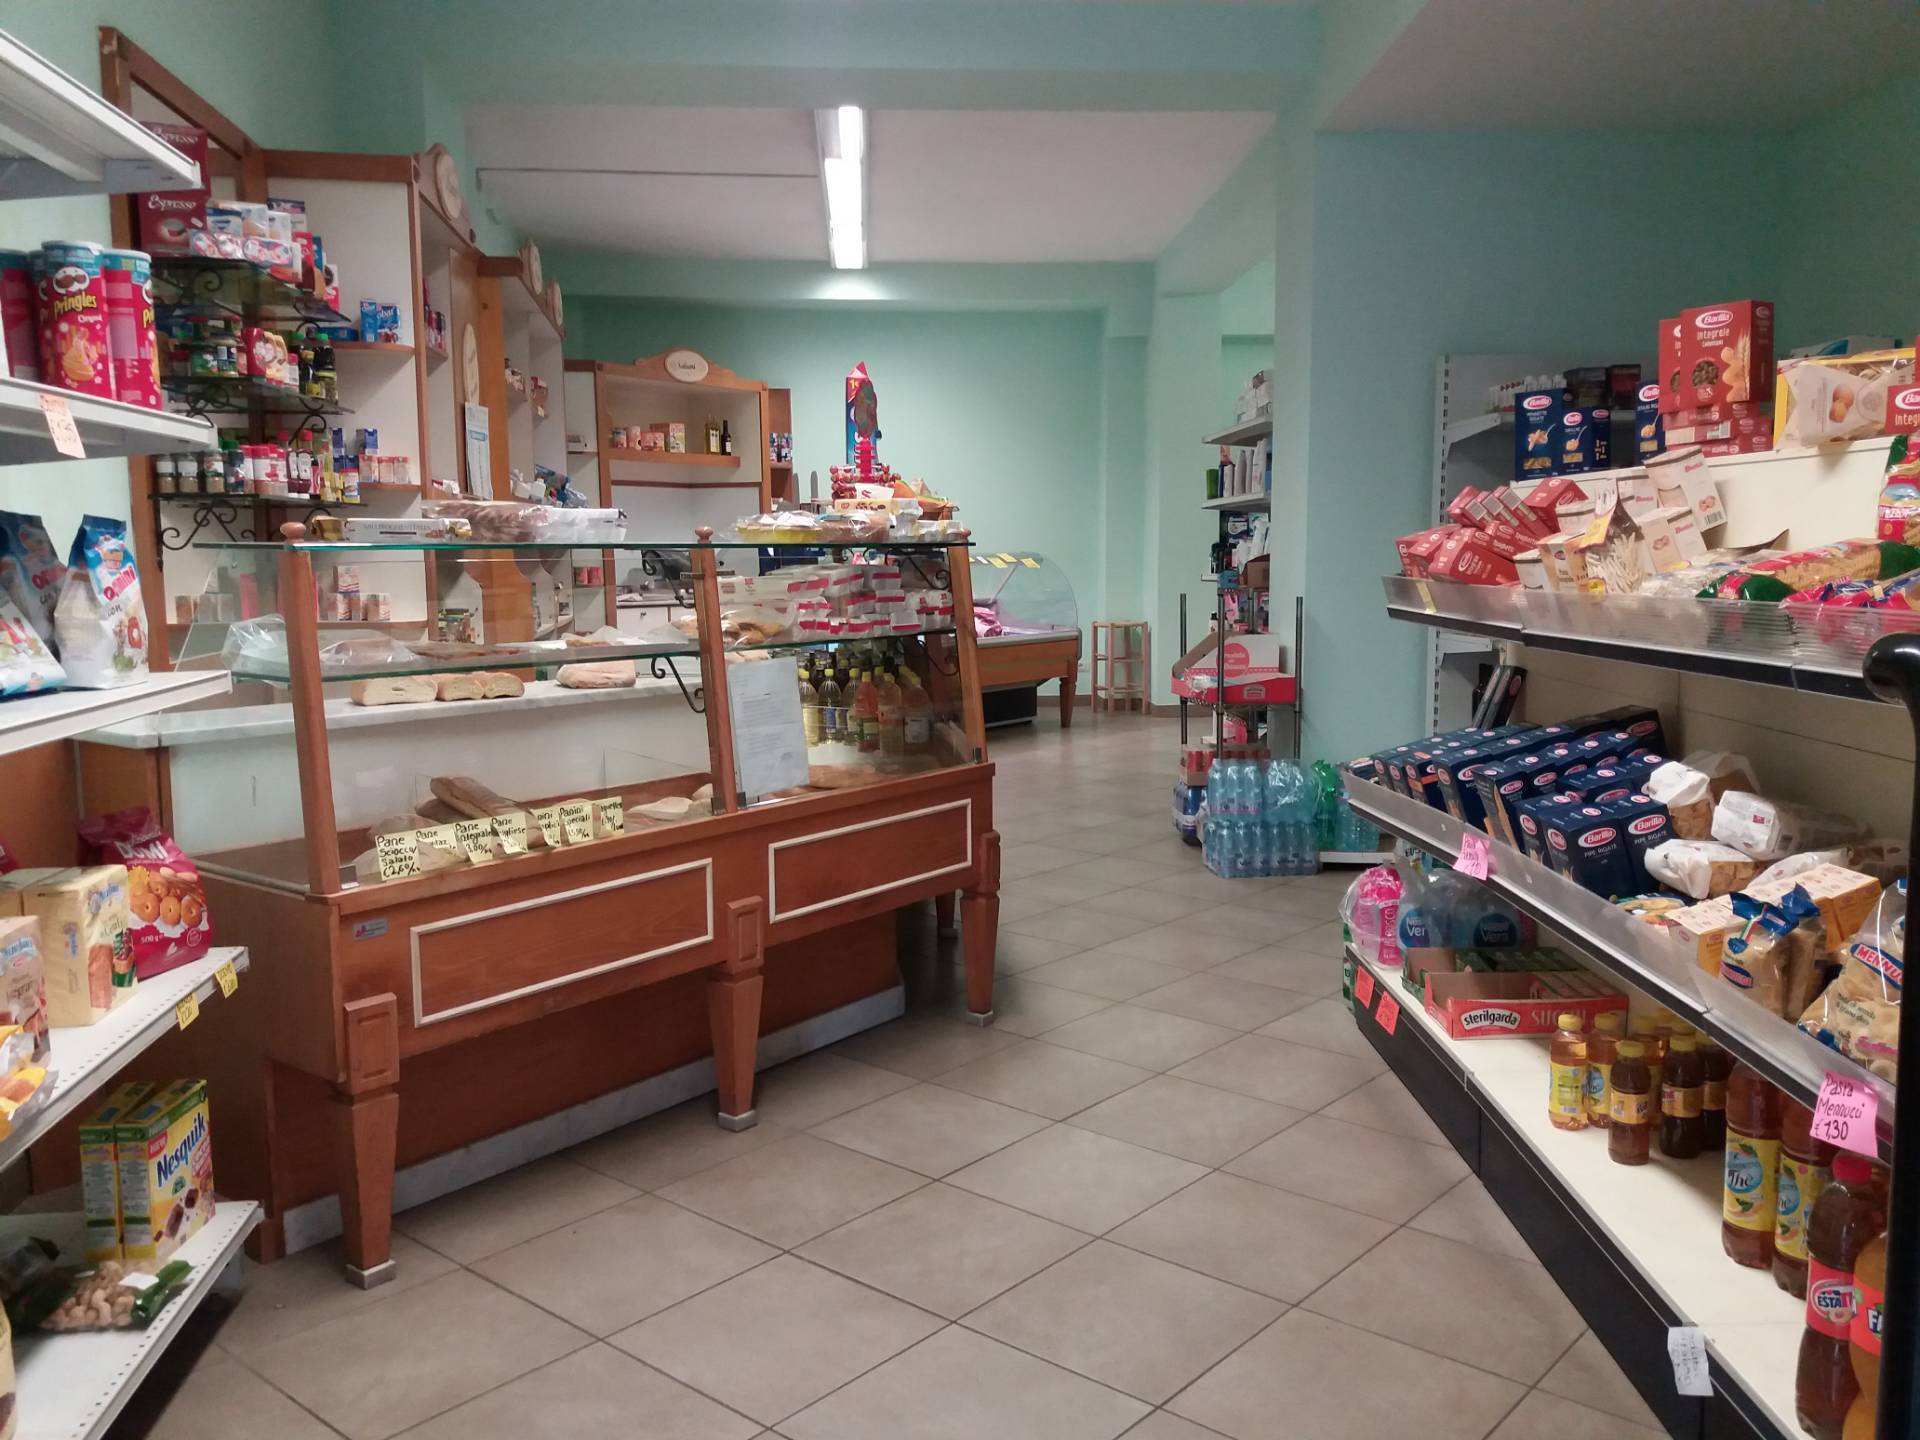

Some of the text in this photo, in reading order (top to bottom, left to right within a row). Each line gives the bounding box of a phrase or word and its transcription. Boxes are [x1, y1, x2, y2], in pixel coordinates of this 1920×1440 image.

[54, 291, 97, 321] Pringles
[1703, 313, 1731, 325] Barilla
[1696, 327, 1731, 341] Integrale
[559, 804, 583, 818] Panini
[455, 823, 480, 834] Pane
[492, 817, 513, 829] Pane
[1637, 817, 1663, 831] Barilla
[415, 829, 439, 840] Pane
[1587, 831, 1613, 845] Barilla
[376, 835, 406, 850] Pane
[1463, 1011, 1518, 1027] sterilgarda
[1824, 1072, 1854, 1097] Pasta
[1824, 1120, 1849, 1140] 1,30
[156, 1111, 206, 1188] Nesquik
